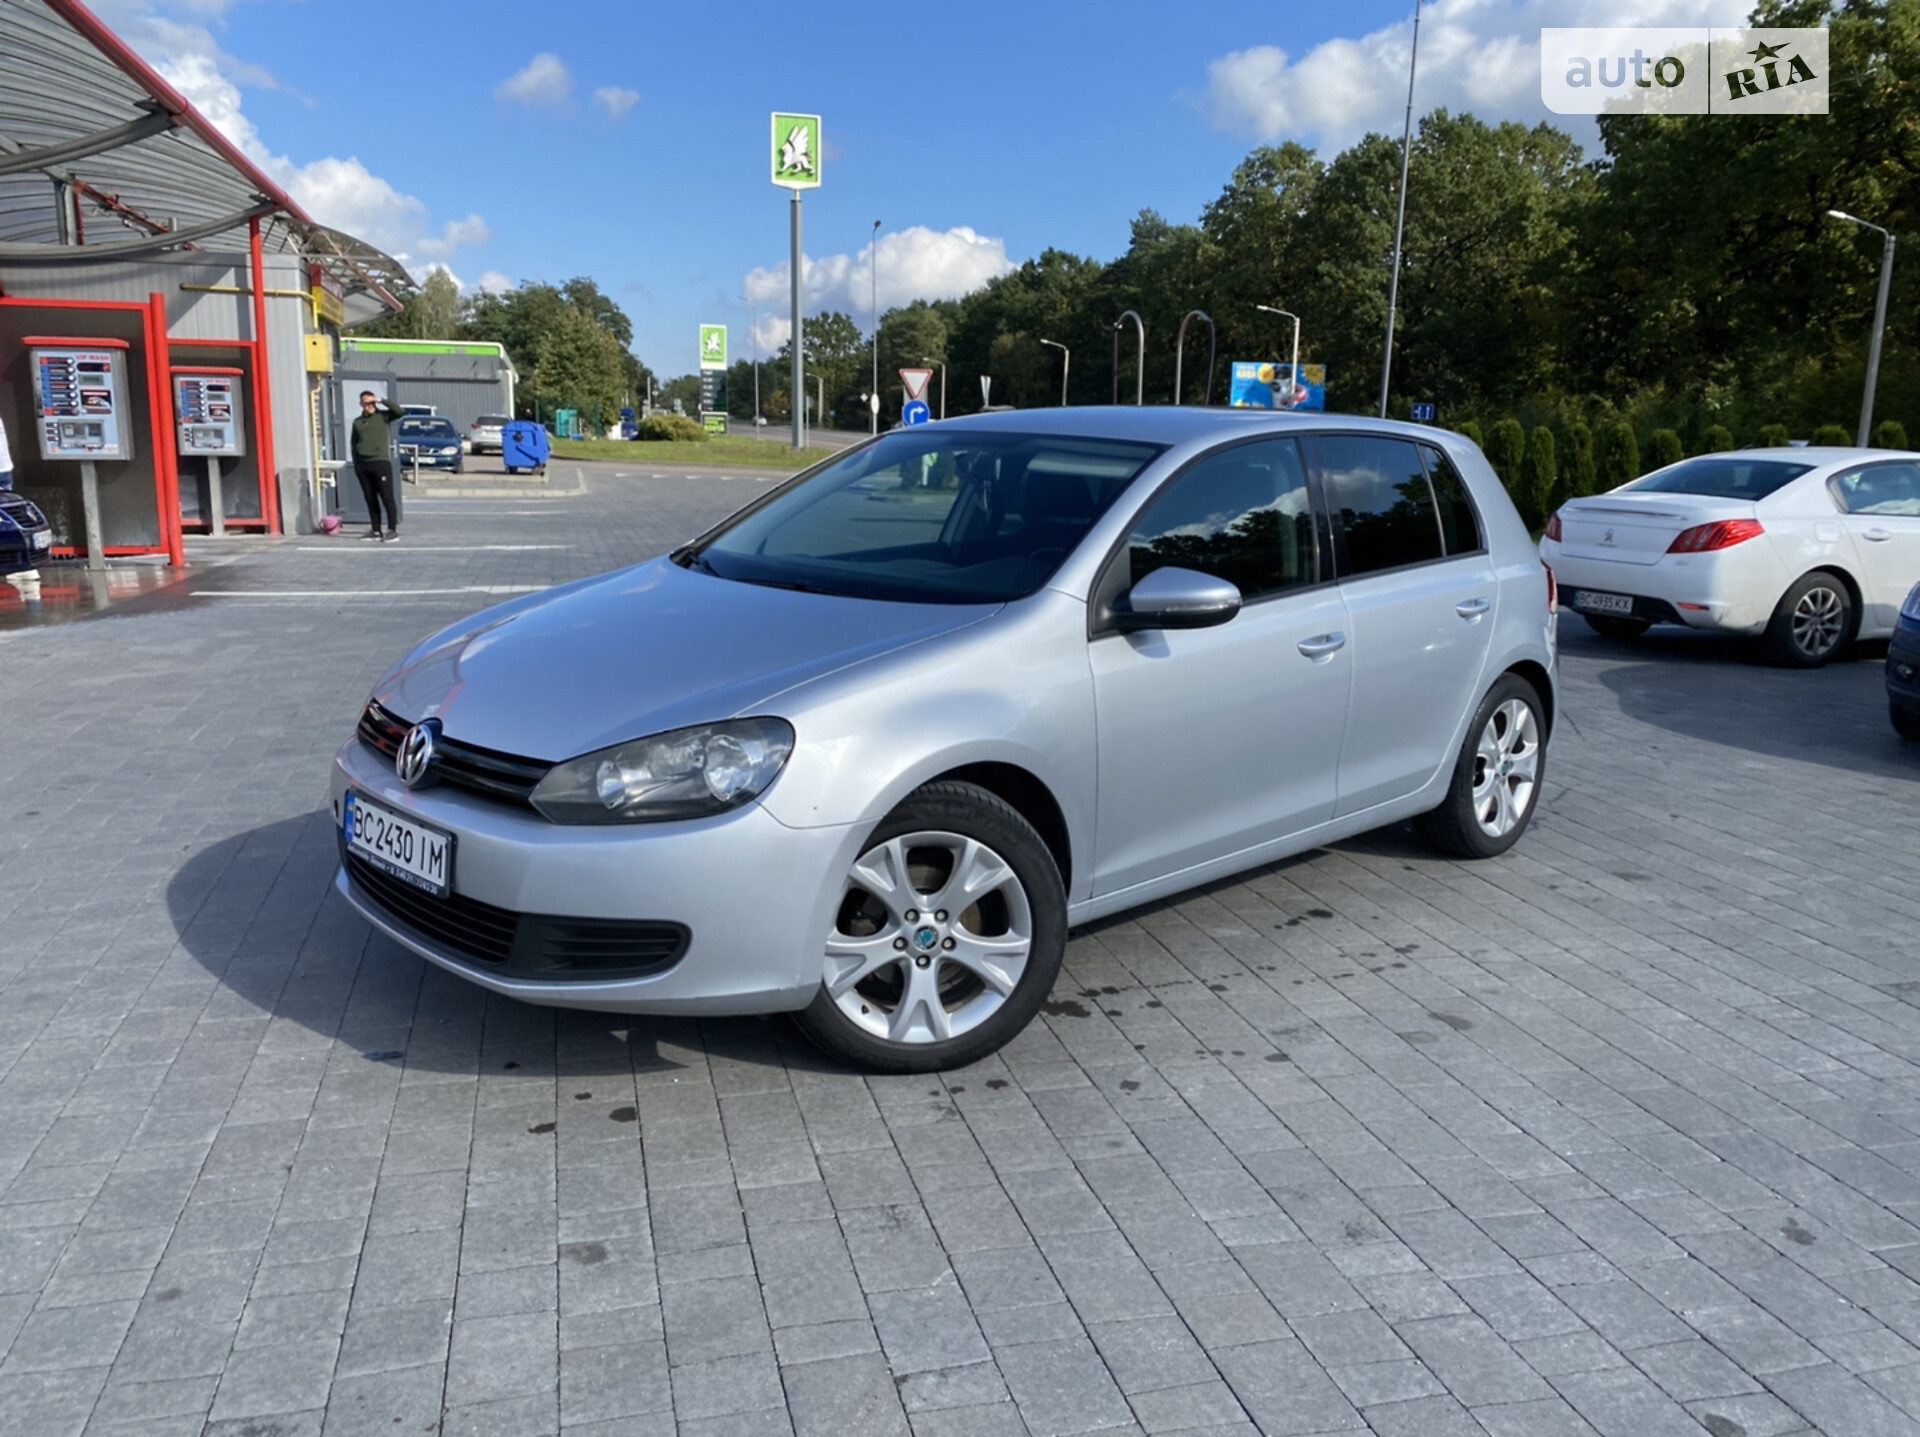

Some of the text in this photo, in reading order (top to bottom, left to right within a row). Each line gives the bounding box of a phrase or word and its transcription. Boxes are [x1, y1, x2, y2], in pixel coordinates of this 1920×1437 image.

[354, 804, 443, 879] BC 2430 IM
